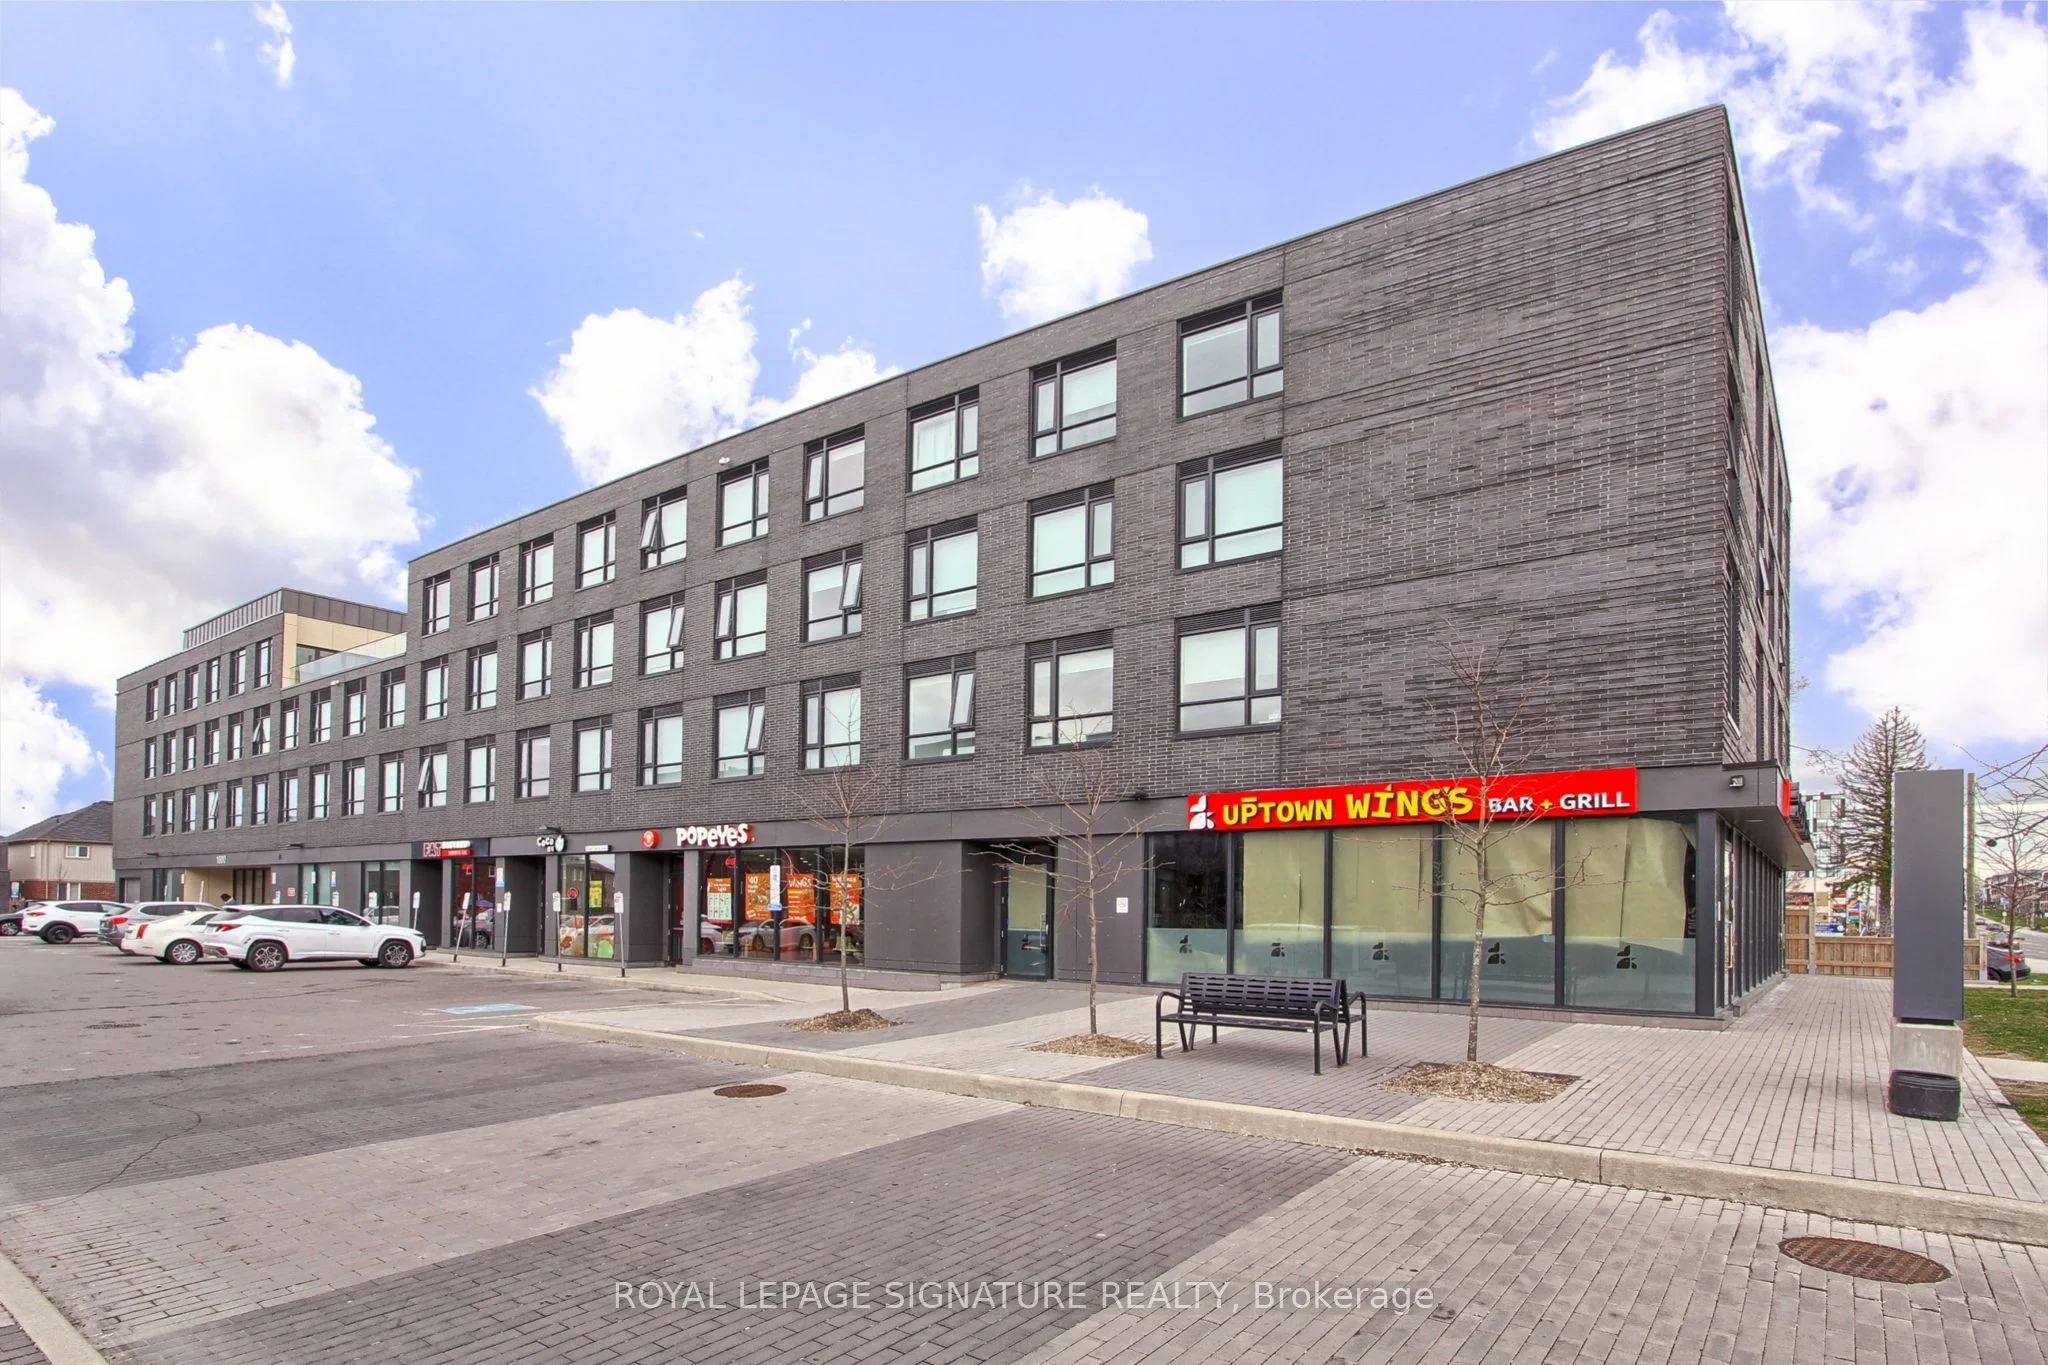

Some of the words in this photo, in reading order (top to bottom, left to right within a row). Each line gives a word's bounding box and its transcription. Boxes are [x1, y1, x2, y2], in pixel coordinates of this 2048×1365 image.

[1488, 797, 1534, 813] BAR
[1559, 791, 1630, 810] GRILL
[423, 841, 442, 858] FAT
